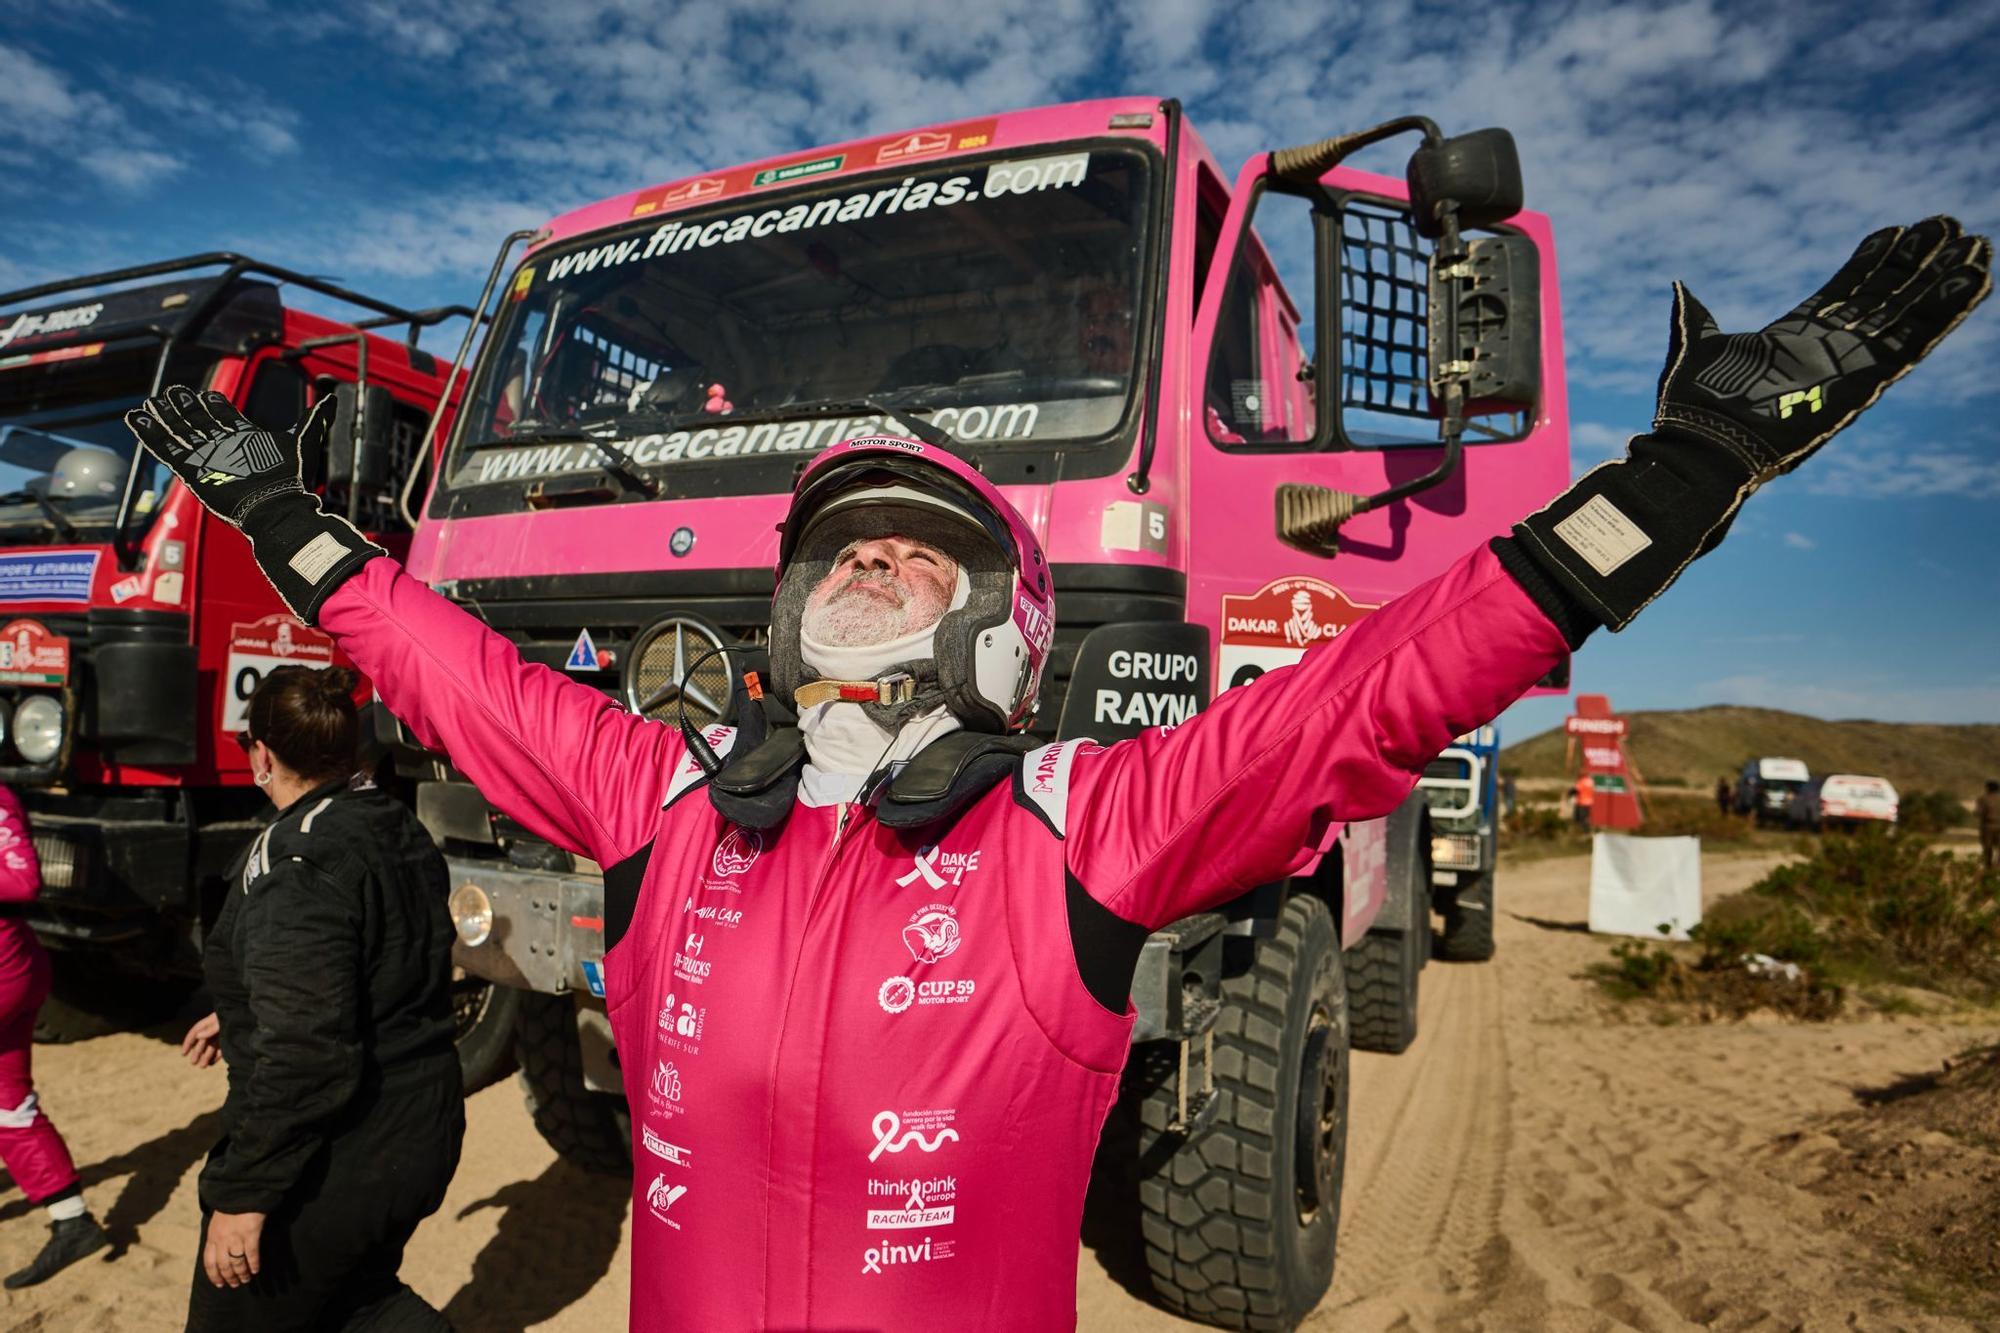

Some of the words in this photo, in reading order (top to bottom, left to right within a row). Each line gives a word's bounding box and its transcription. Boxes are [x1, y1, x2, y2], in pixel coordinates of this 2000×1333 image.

[547, 154, 1086, 281] www.fincacanarias.com
[851, 439, 887, 447] MOTOR
[888, 440, 923, 452] SPORT
[1149, 512, 1165, 540] 5
[1228, 617, 1277, 634] DAKAR
[1107, 649, 1198, 682] GRUPO
[1094, 688, 1198, 726] RAYNA
[1568, 718, 1625, 734] FINISH
[718, 907, 743, 924] CAR
[918, 981, 955, 996] CUP
[957, 980, 975, 995] 59
[918, 997, 945, 1005] MOTOR
[946, 995, 970, 1003] SPORT
[868, 1178, 910, 1195] think
[922, 1175, 957, 1199] pink
[925, 1191, 956, 1202] europe
[872, 1214, 917, 1224] RACING
[918, 1210, 950, 1222] TEAM
[881, 1236, 932, 1265] invi
